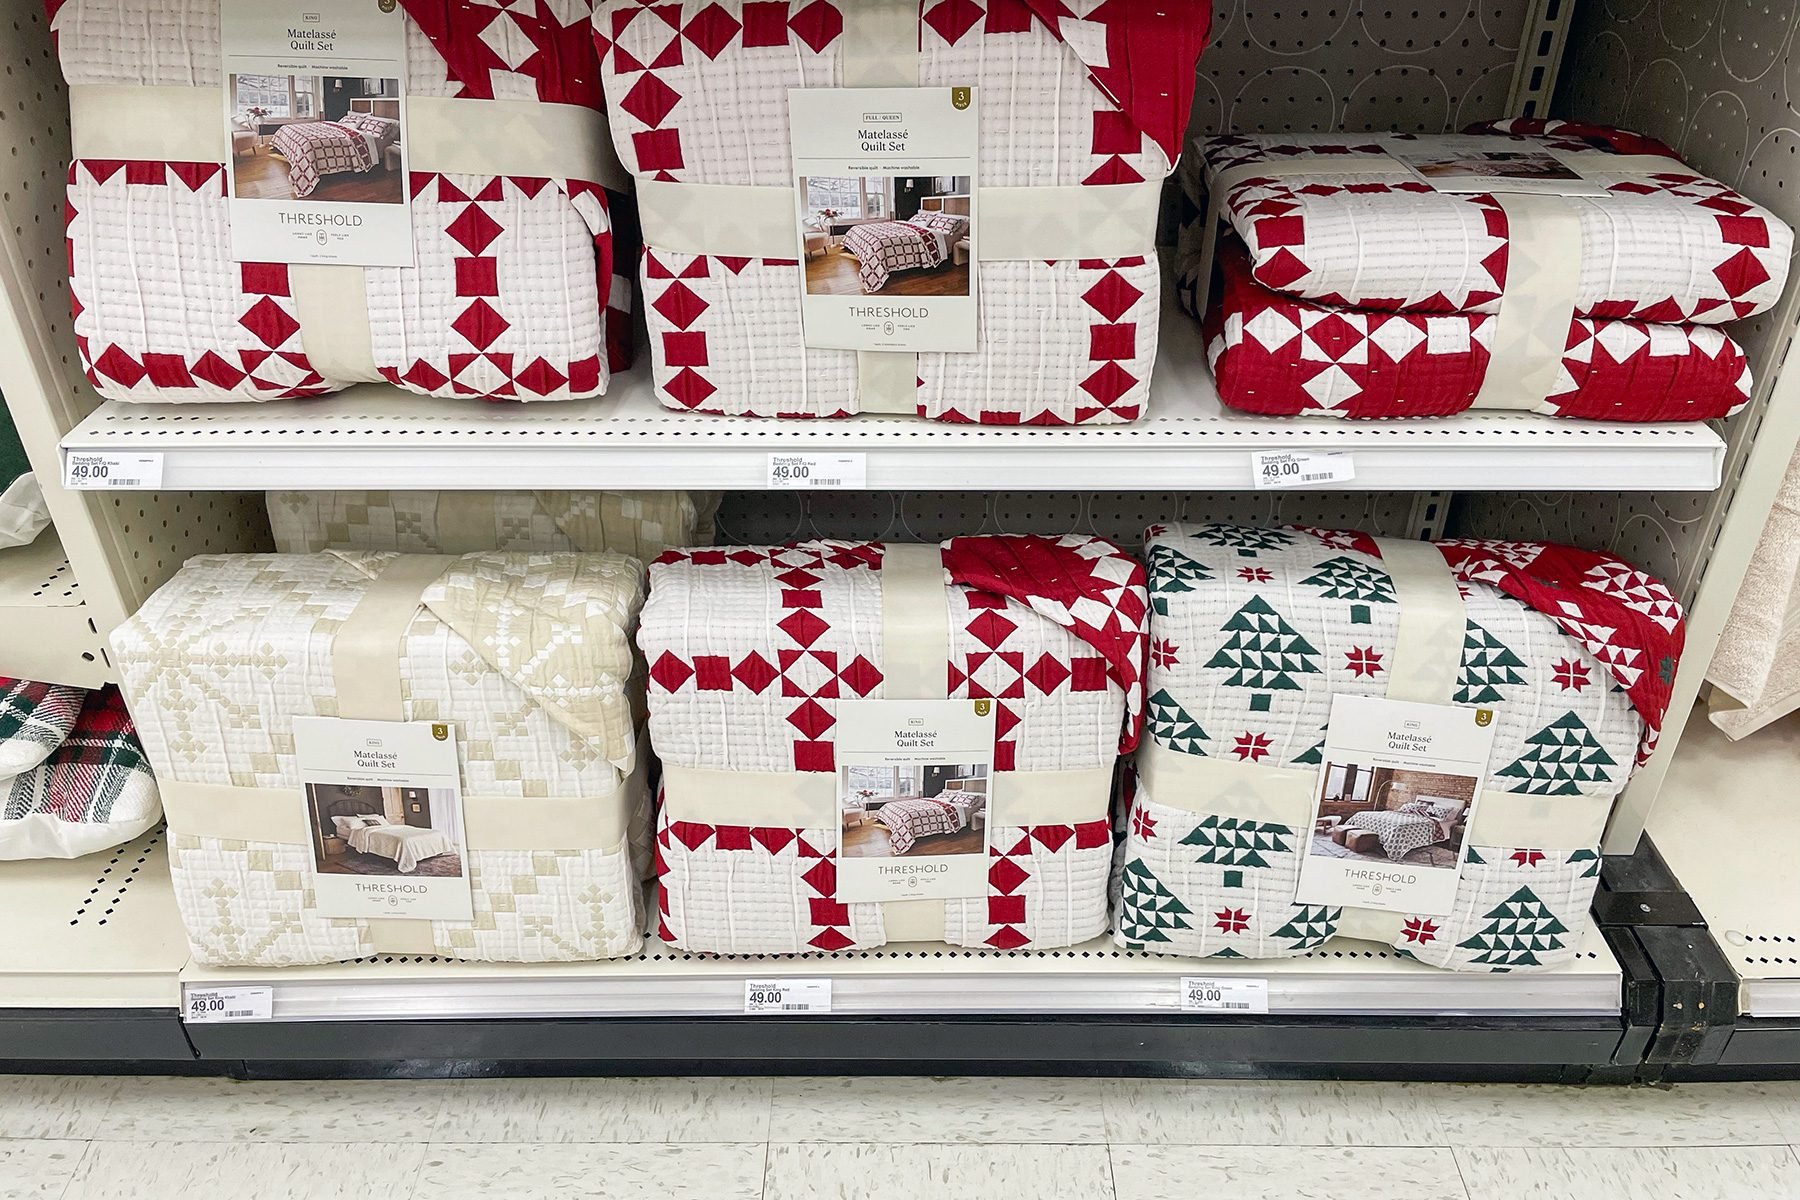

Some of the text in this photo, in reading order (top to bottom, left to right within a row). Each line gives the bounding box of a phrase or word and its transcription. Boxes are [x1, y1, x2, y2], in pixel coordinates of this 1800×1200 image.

[287, 28, 337, 39] Matelassé
[290, 40, 334, 51] Quilt Set
[958, 91, 965, 101] 3
[857, 129, 909, 140] Matelassé
[861, 141, 906, 152] Quilt Set
[278, 212, 363, 227] THRESHOLD
[849, 306, 929, 319] THRESHOLD
[1261, 454, 1292, 462] Threshold
[71, 465, 109, 478] 49.00
[772, 466, 809, 478] 49.00
[1262, 462, 1300, 477] 49.00
[980, 702, 985, 710] 3
[1481, 712, 1487, 721] 3
[437, 727, 443, 735] 3
[894, 729, 938, 739] Matelassé
[1387, 731, 1433, 744] Matelassé
[897, 739, 935, 748] Quilt Set
[1388, 741, 1428, 753] Quilt Set
[353, 750, 398, 760] Matelassé
[357, 759, 396, 769] Quilt Set
[878, 863, 949, 875] THRESHOLD
[1344, 868, 1417, 885] THRESHOLD
[355, 883, 428, 894] THRESHOLD
[749, 992, 782, 1003] 49.00
[1188, 989, 1221, 1002] 49.00
[191, 1000, 225, 1011] 49.00
